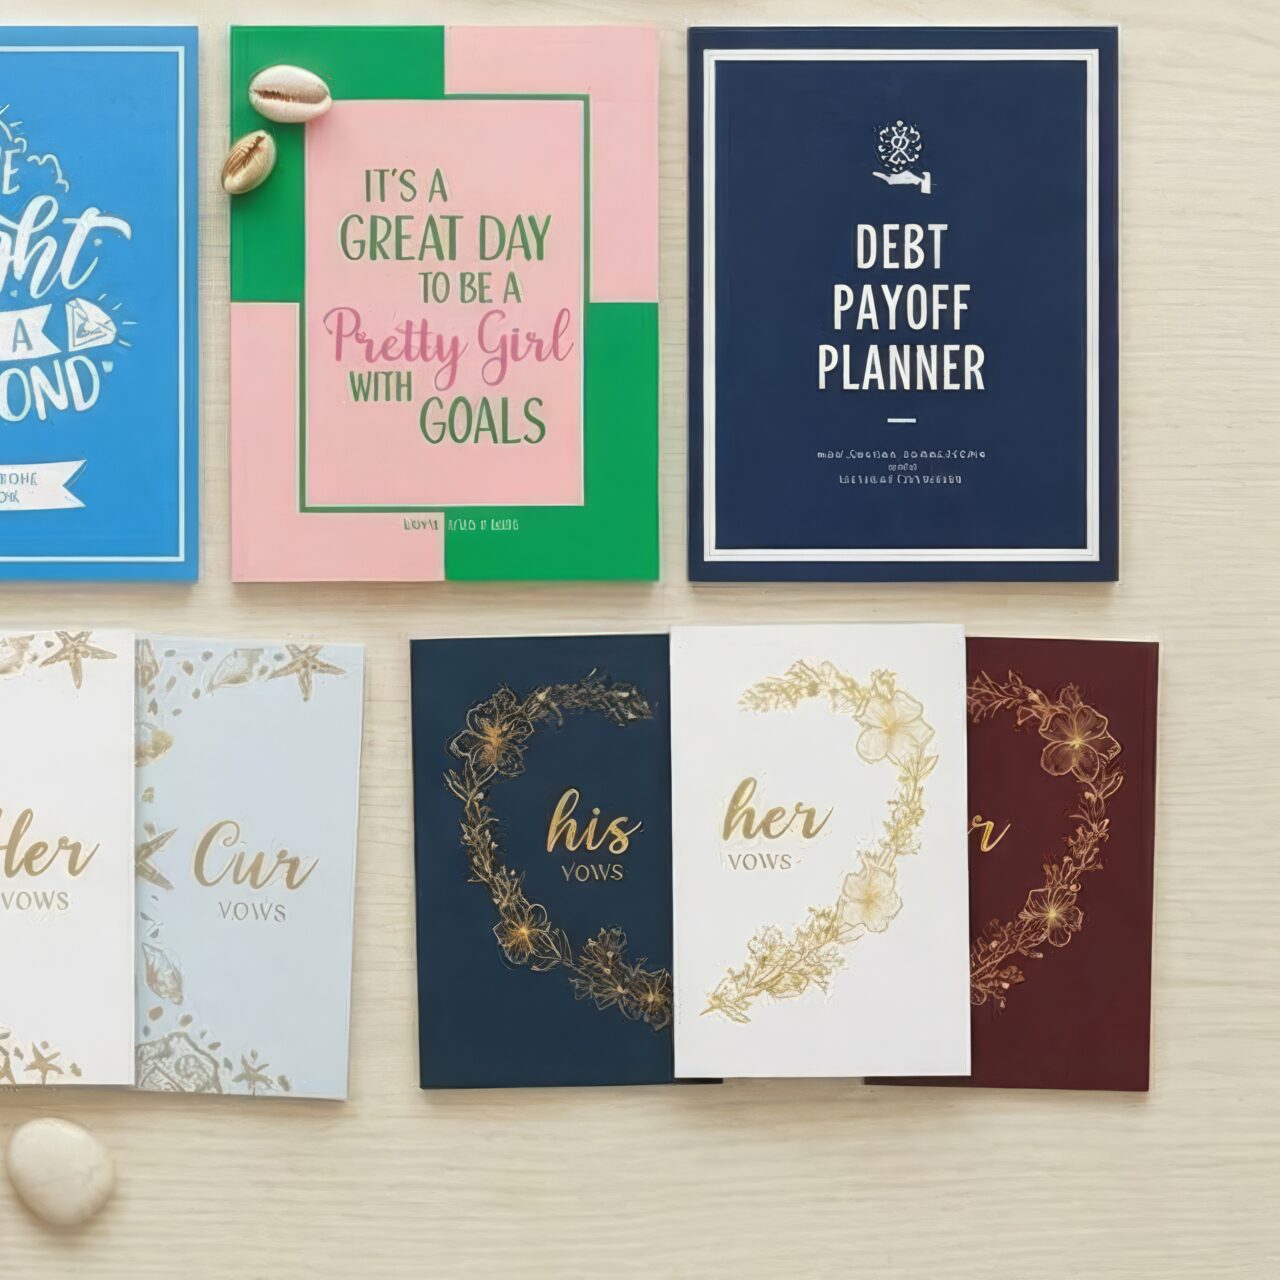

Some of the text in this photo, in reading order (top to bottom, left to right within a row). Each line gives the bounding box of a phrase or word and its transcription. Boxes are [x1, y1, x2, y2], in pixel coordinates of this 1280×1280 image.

[365, 167, 449, 203] IT'S A
[339, 213, 552, 262] GREAT DAY
[856, 223, 949, 270] DEBT
[418, 270, 523, 304] TO BE A
[833, 283, 971, 331] PAYOFF
[11, 317, 34, 352] A
[322, 306, 575, 393] Pretty Girl
[349, 370, 413, 403] WITH
[818, 344, 986, 391] PLANNER
[419, 395, 546, 445] GOALS
[546, 787, 643, 855] his
[722, 776, 835, 842] her
[727, 852, 793, 871] VOWS
[0, 890, 70, 911] VOWS
[218, 900, 287, 923] VOWS
